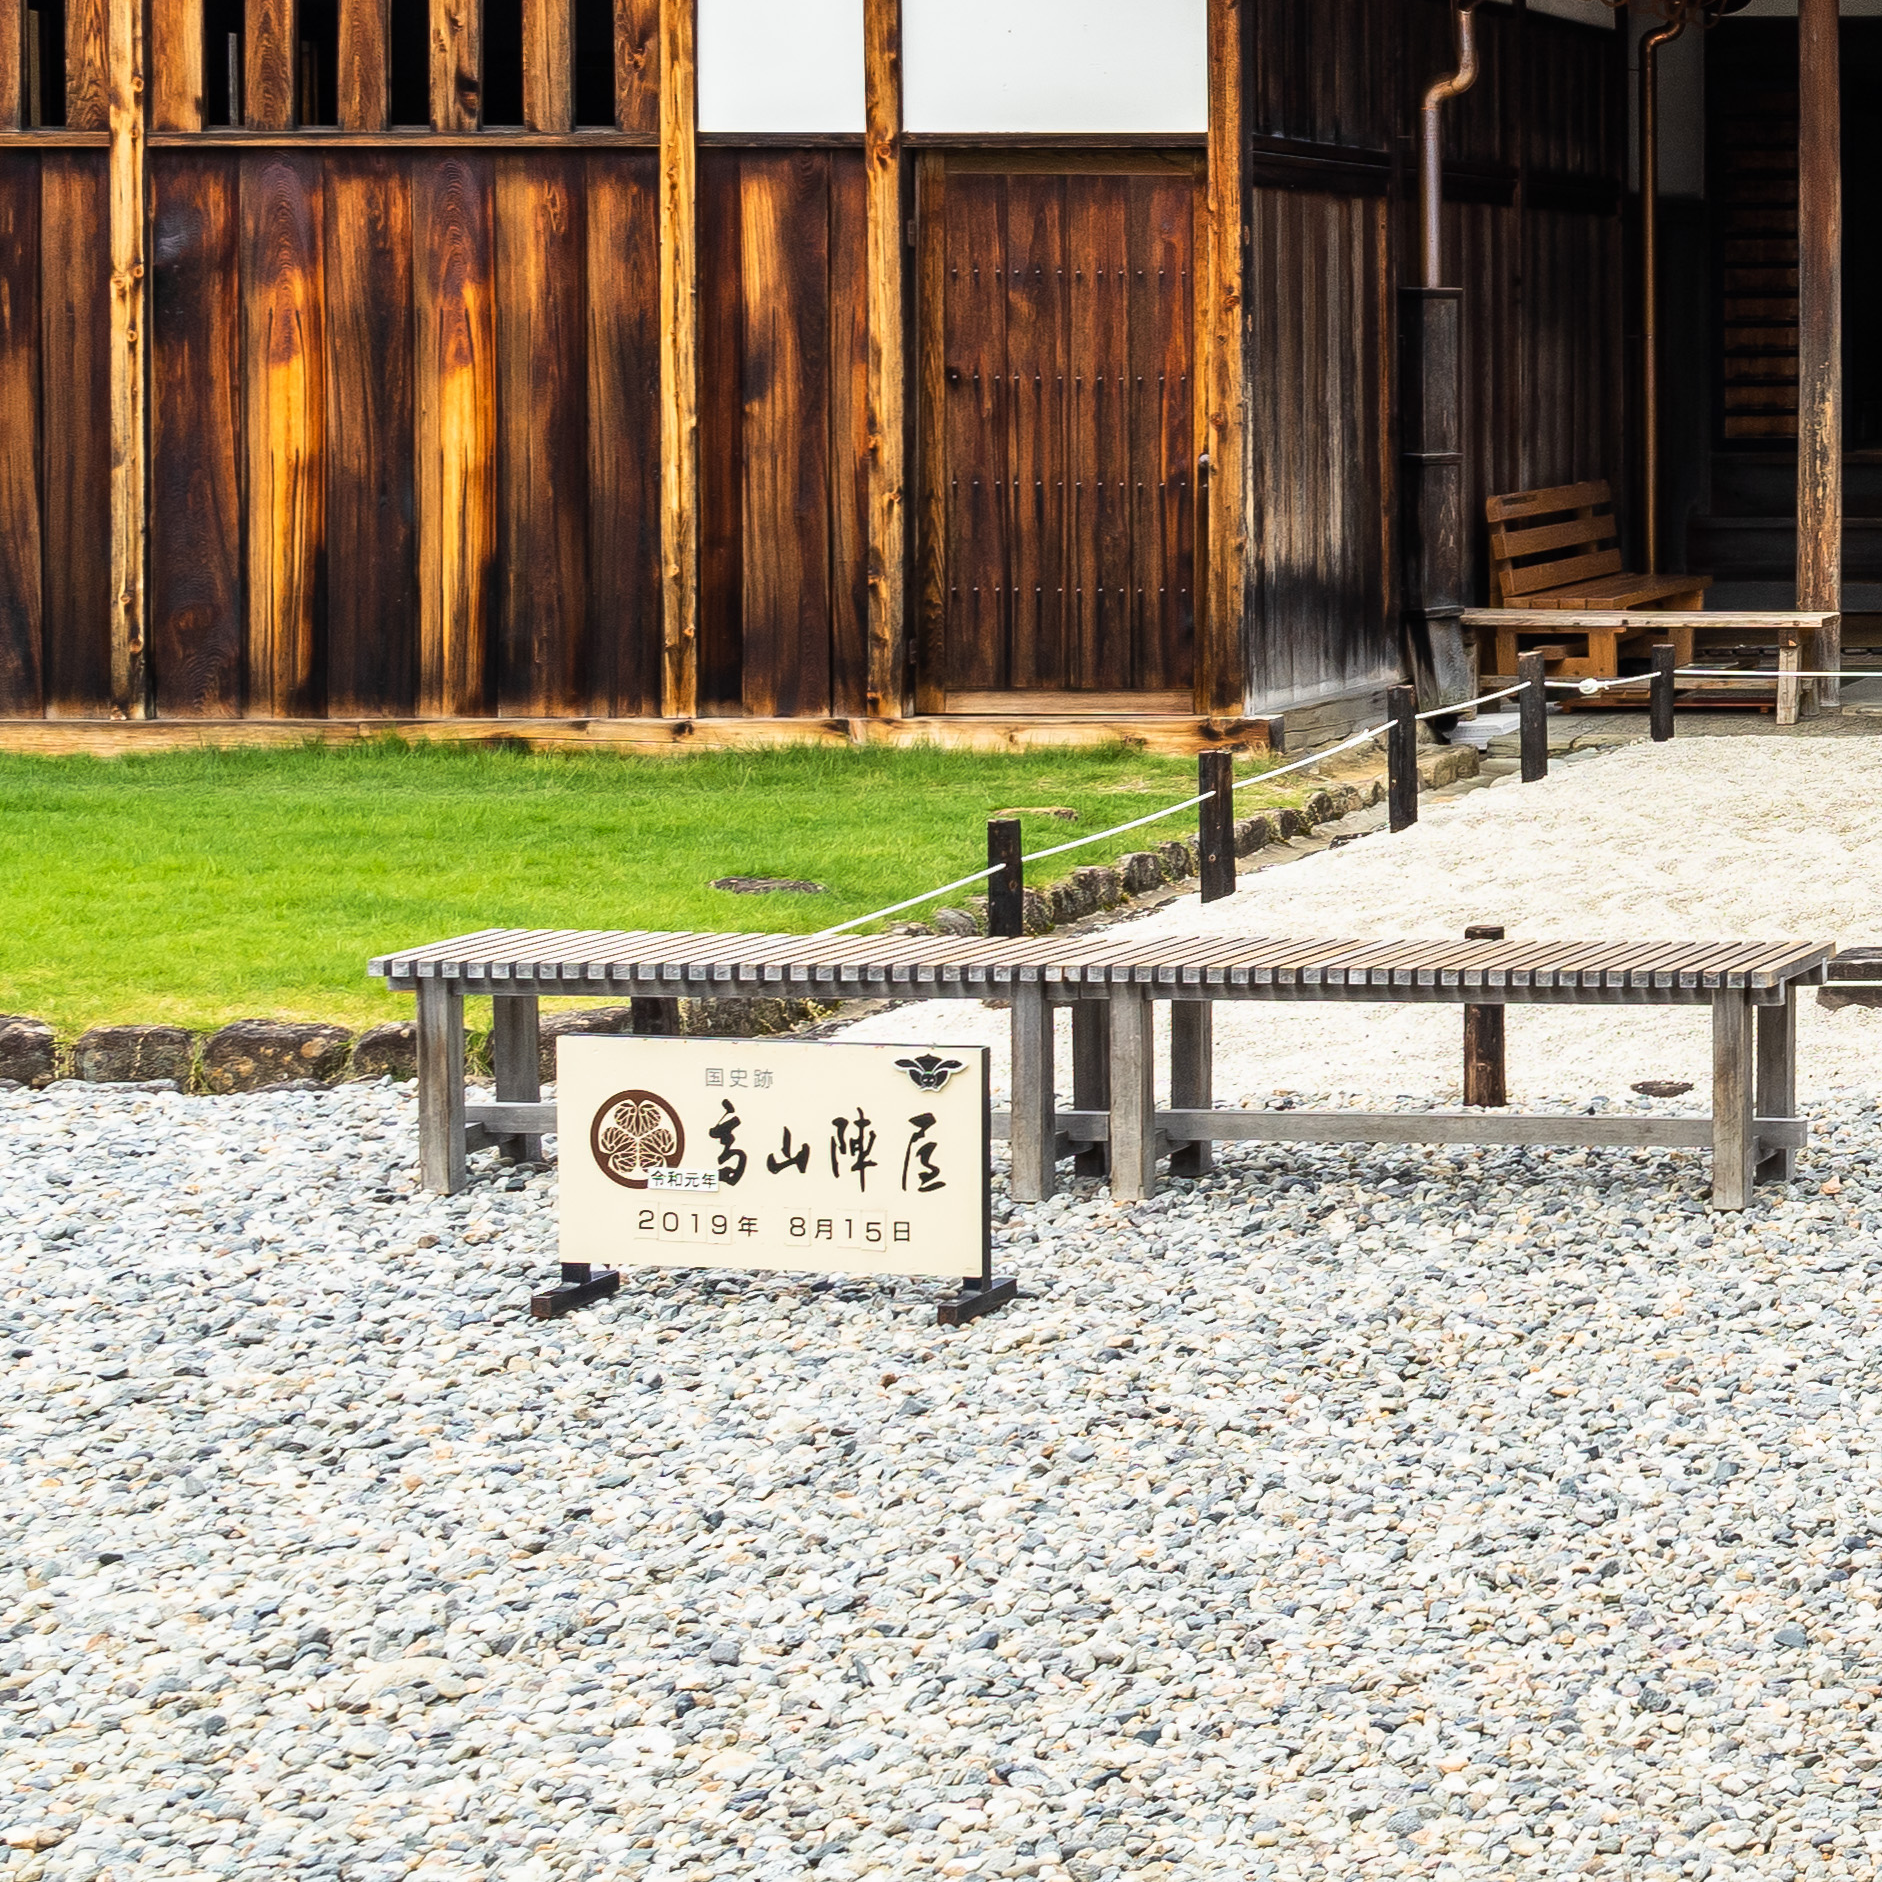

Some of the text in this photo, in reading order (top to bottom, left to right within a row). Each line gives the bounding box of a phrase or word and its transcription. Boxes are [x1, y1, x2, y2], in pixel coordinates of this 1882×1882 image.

[705, 1067, 774, 1089] 国史跡
[709, 1098, 947, 1193] 高山陣屋
[650, 1170, 718, 1189] 令和元年
